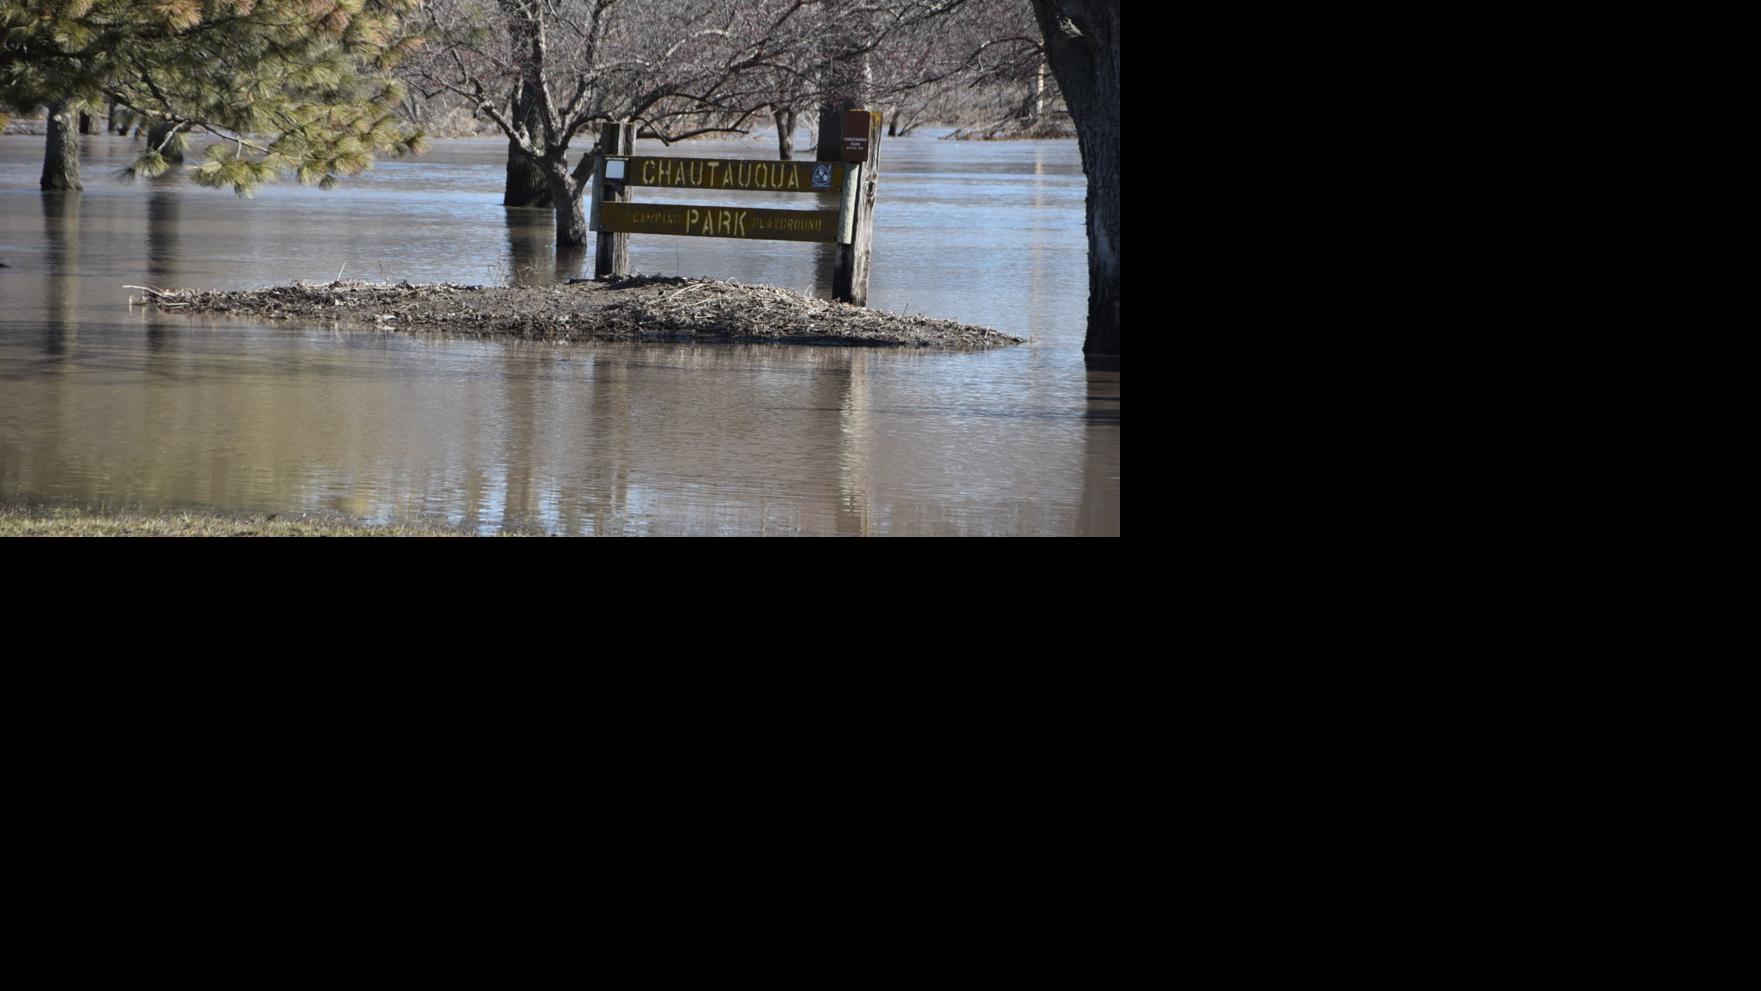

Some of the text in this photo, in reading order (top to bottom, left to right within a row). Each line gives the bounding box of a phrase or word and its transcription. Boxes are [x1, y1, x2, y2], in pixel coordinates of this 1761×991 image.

[641, 160, 800, 189] CHAUTAUQUA
[686, 208, 748, 237] PARK
[752, 217, 822, 232] PLAYGROUND
